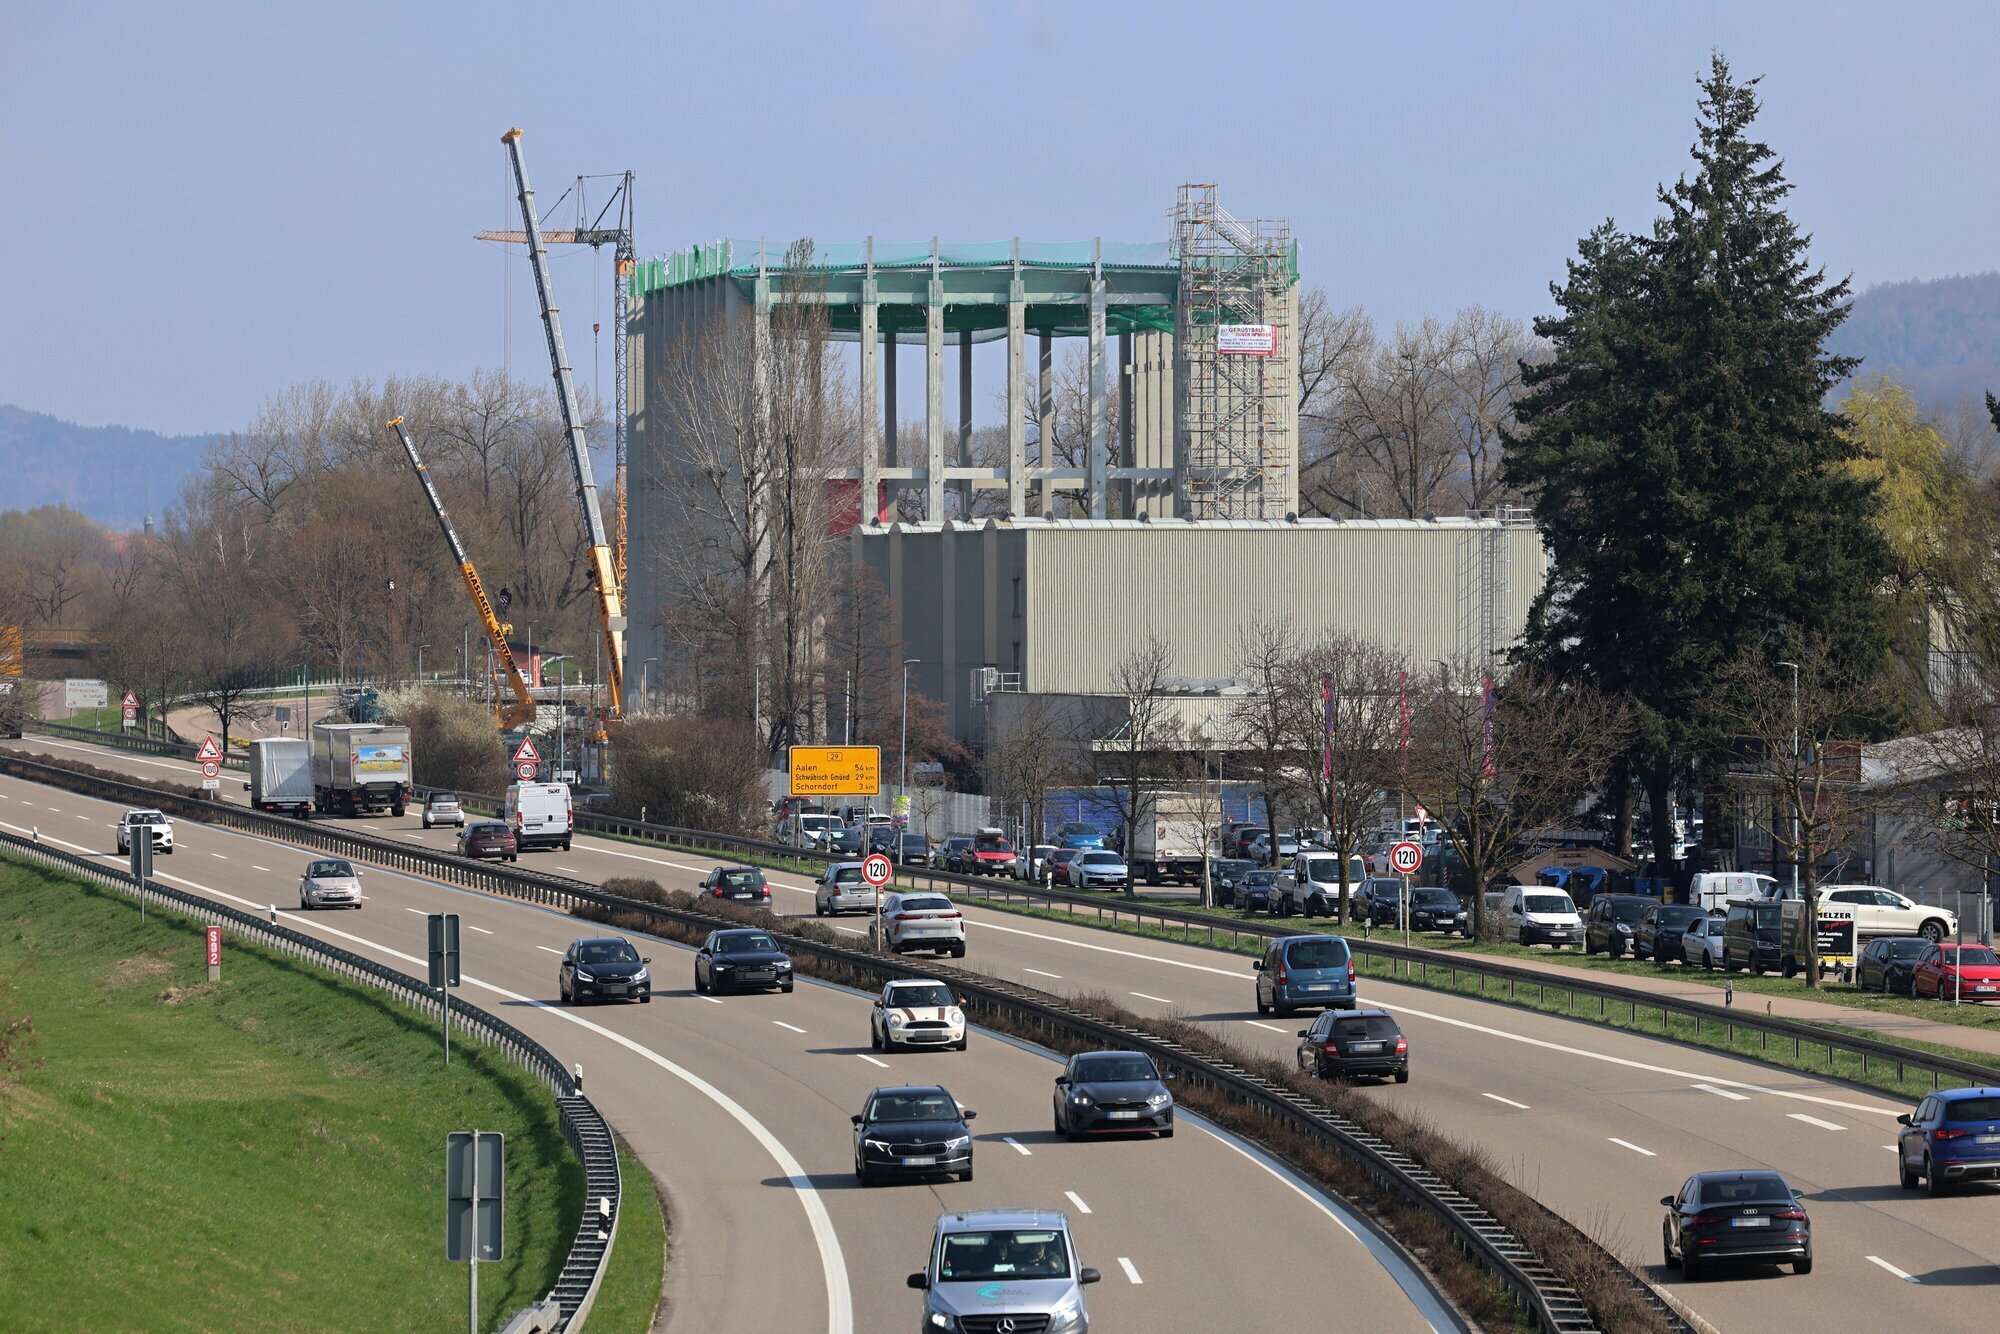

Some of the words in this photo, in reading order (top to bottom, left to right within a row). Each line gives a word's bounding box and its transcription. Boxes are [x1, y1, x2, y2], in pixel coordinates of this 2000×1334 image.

[468, 571, 492, 615] HASLACH
[494, 630, 518, 674] WERTACH
[522, 766, 532, 775] 100
[1398, 851, 1415, 864] 120
[869, 863, 886, 877] 120
